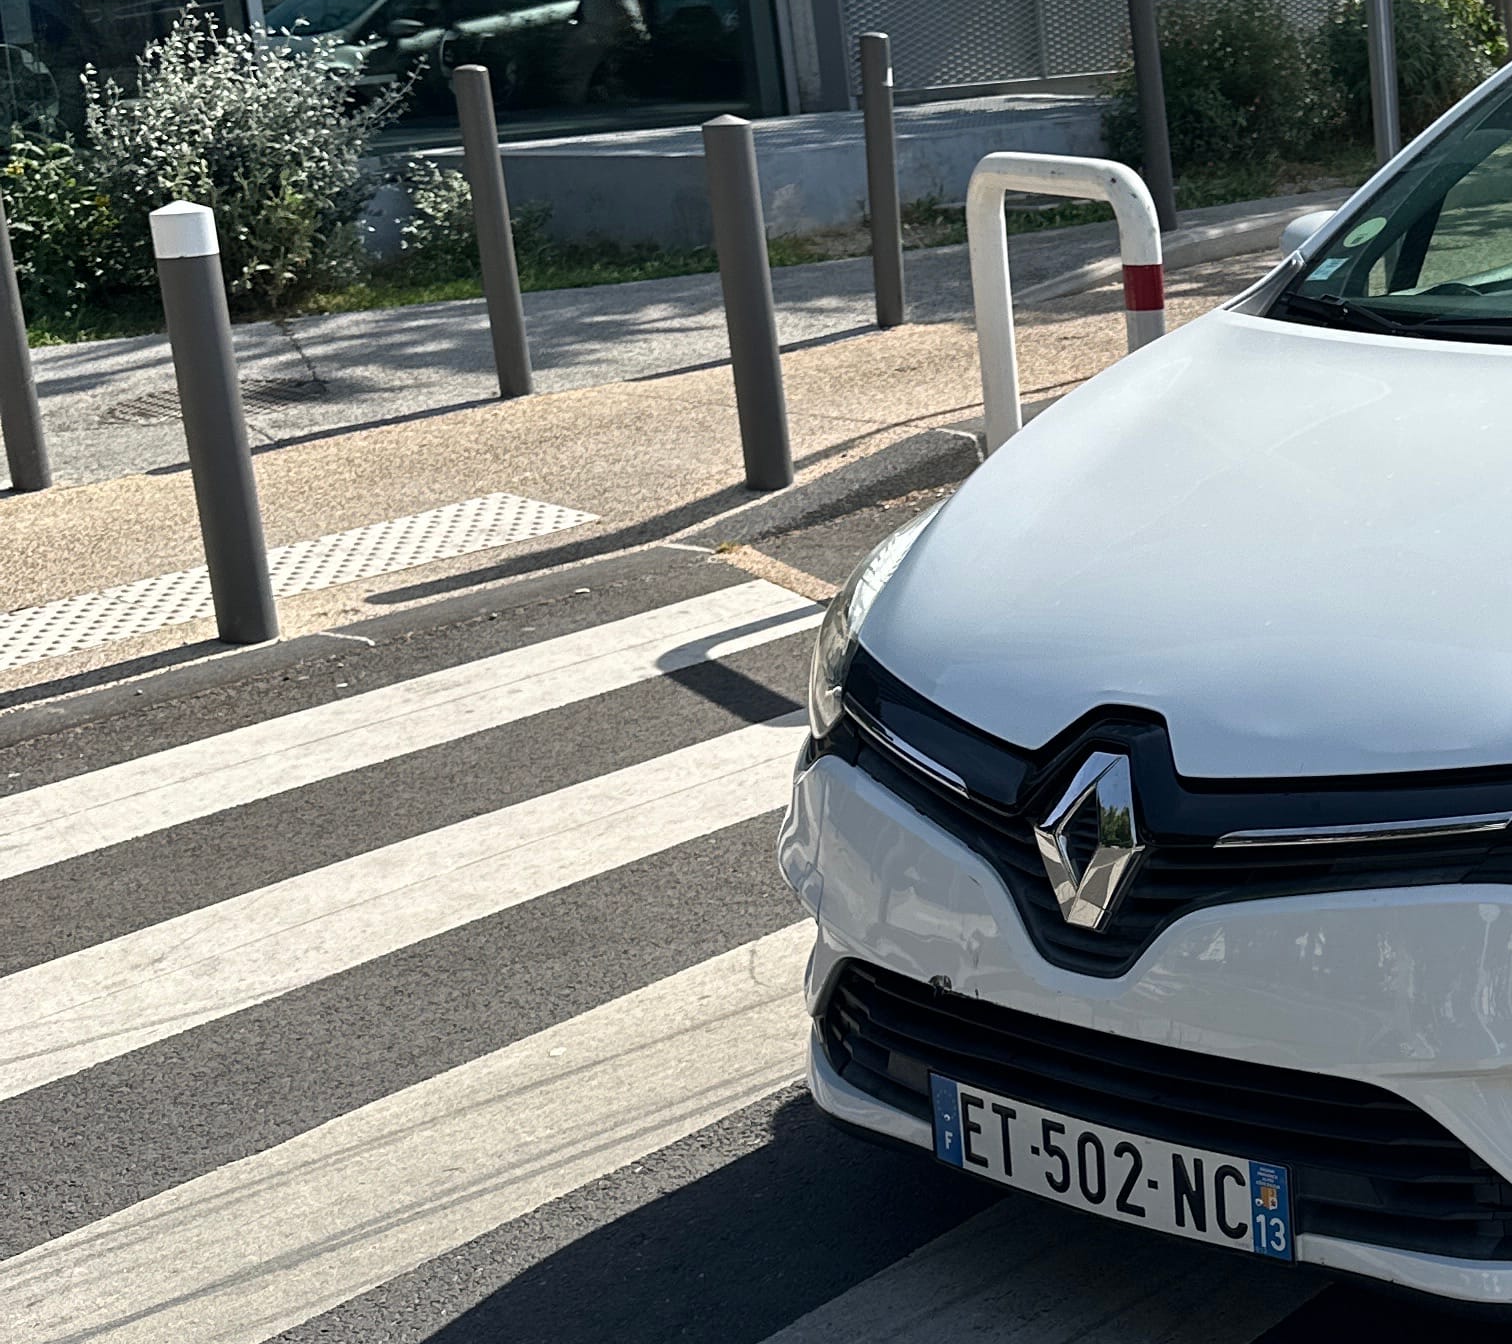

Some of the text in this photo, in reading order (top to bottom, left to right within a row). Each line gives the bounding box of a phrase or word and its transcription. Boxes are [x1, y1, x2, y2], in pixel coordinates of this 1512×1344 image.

[944, 1130, 954, 1150] F
[960, 1091, 1248, 1240] ET-502-NC
[1256, 1214, 1286, 1252] 13
